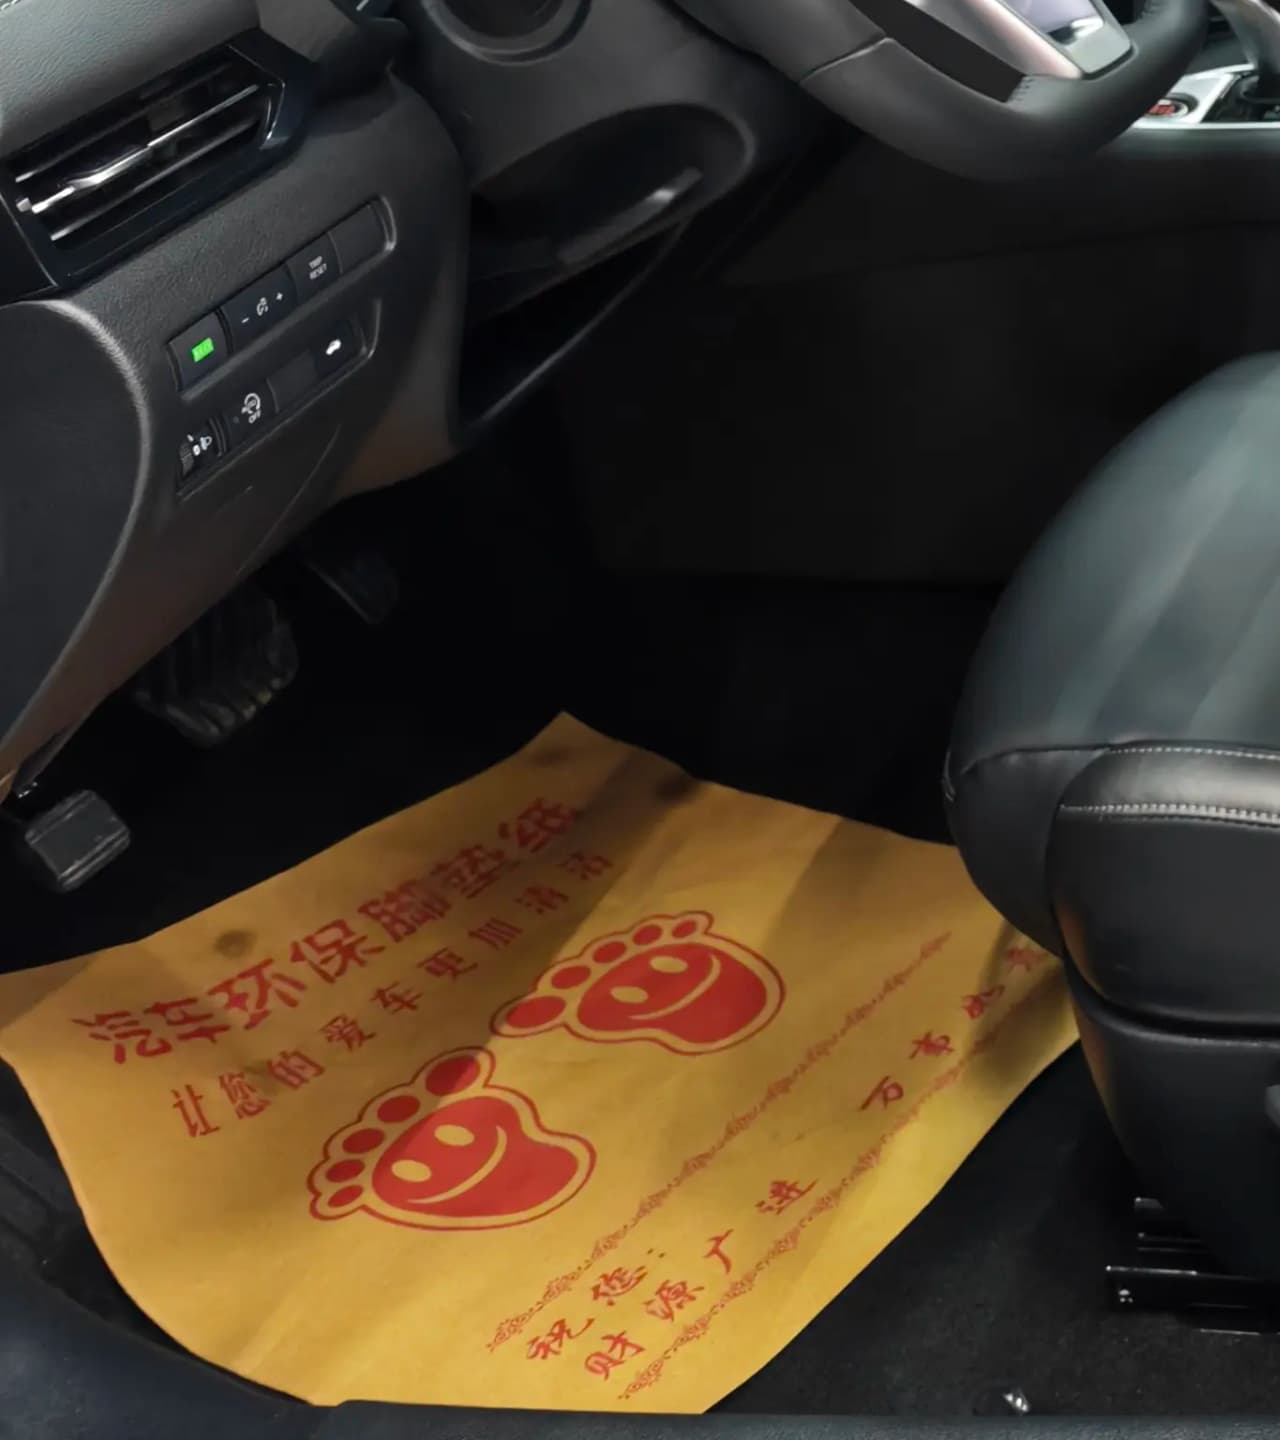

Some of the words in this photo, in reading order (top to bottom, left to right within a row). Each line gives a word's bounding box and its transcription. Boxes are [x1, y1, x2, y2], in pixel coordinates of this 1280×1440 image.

[71, 797, 579, 1065] 汽车环保脚垫纸
[170, 849, 615, 1139] 让您的爱车更加清洁
[584, 1178, 819, 1381] 财源广进
